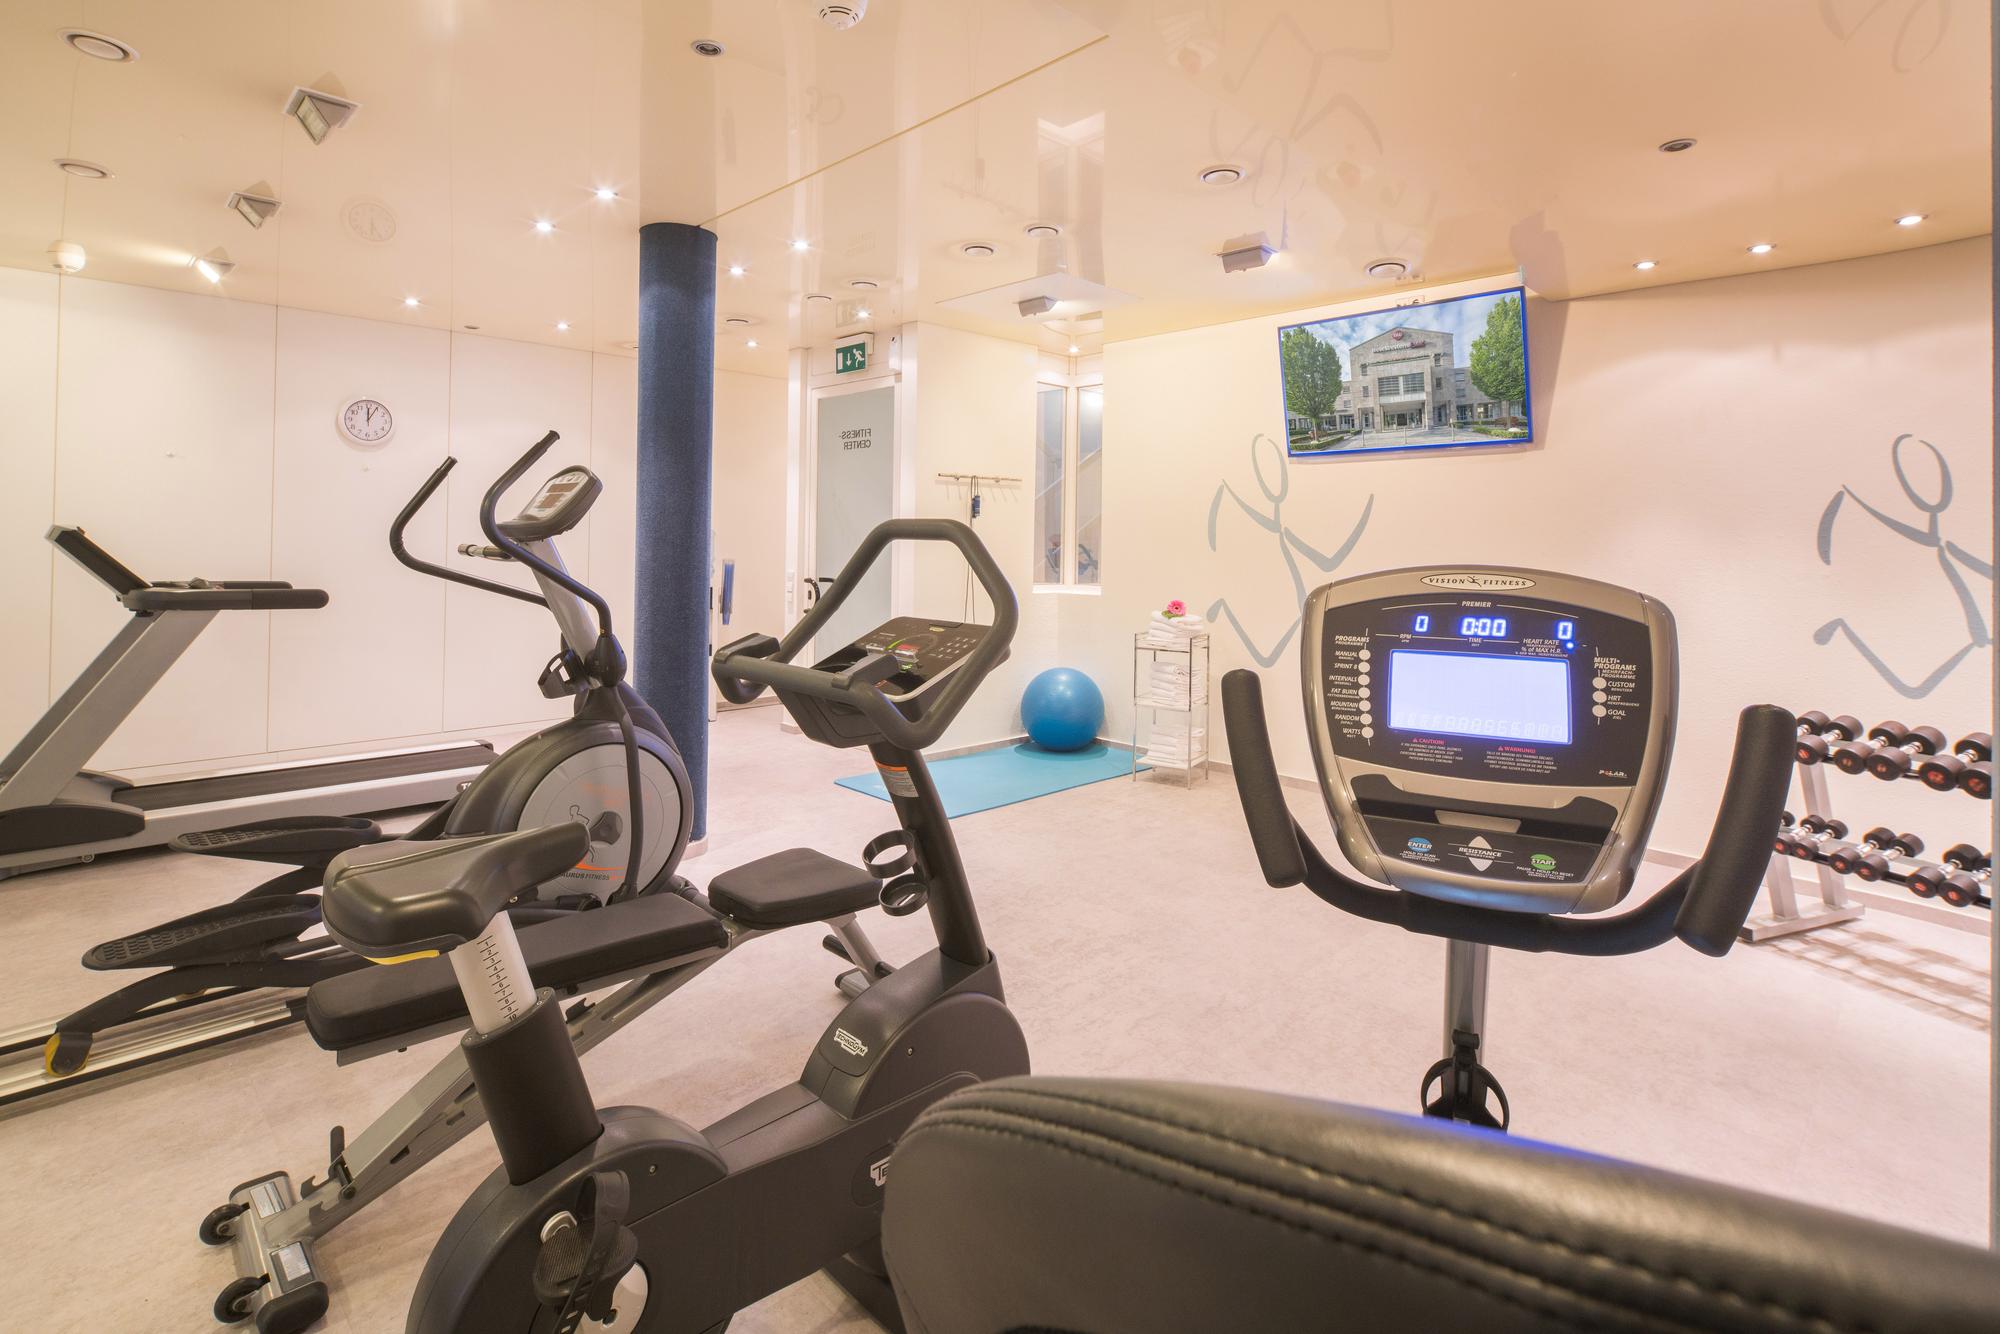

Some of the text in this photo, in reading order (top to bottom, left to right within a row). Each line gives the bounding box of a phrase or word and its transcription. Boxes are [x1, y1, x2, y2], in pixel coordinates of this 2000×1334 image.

[1461, 600, 1492, 608] PREMIER
[1414, 615, 1429, 632] 0
[1461, 616, 1507, 637] 0:00
[1558, 621, 1573, 640] 0
[1335, 635, 1370, 643] PROGRAMS
[1593, 656, 1620, 664] MULTI-
[1593, 662, 1637, 671] PROGRAMS
[1607, 680, 1636, 688] CUSTOM
[1330, 700, 1359, 708] MOUNTAIN
[1334, 713, 1360, 721] RANDOM
[1607, 709, 1627, 717] GOAL
[1342, 727, 1361, 735] WATTS
[1407, 841, 1433, 849] ENTER
[1458, 847, 1503, 858] RESISTANCE
[1530, 858, 1557, 866] START
[509, 1013, 517, 1021] 10
